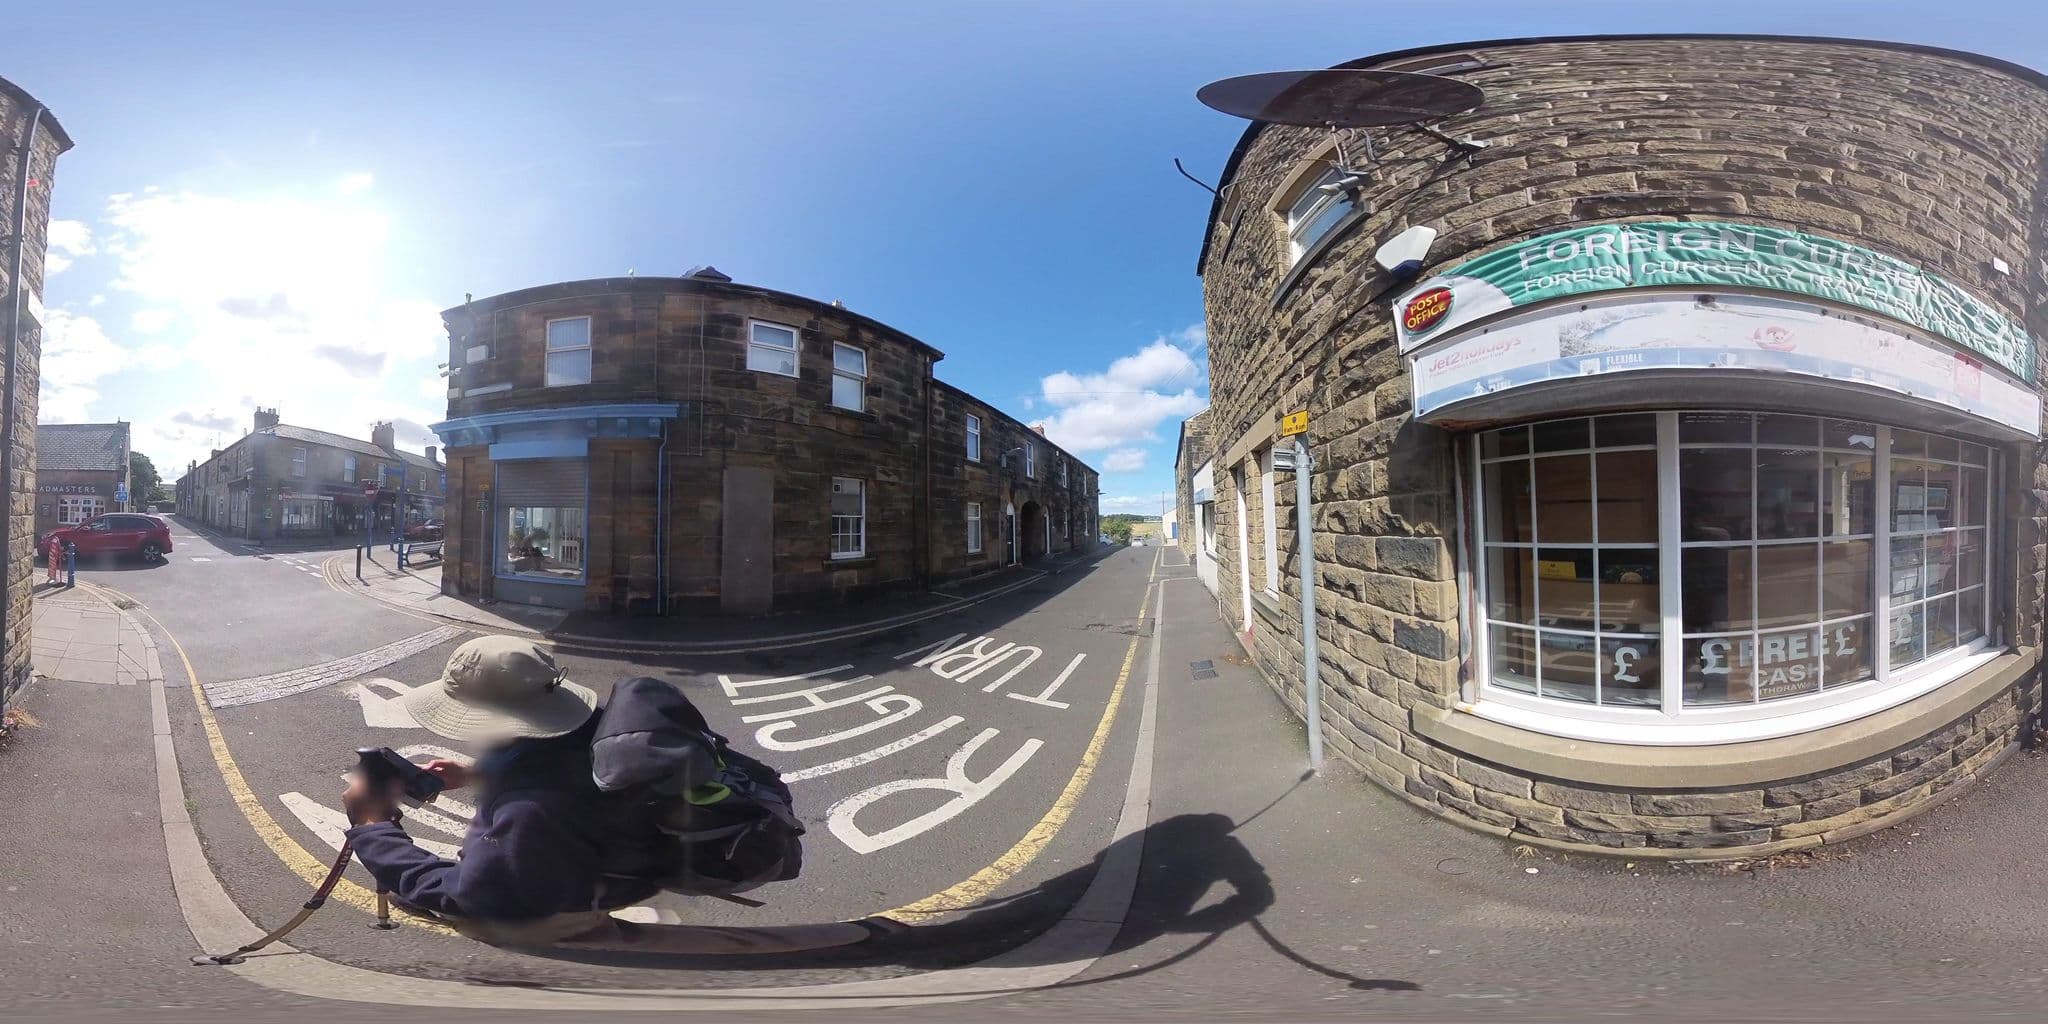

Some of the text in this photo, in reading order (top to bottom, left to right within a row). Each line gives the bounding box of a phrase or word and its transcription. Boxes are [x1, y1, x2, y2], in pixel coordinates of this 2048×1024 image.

[1519, 229, 1756, 271] FOREIGN
[1524, 264, 1633, 293] FOREIGN
[1641, 257, 1793, 284] CURRENCY
[1407, 302, 1446, 329] OFFICE
[1410, 292, 1441, 316] POST
[1429, 340, 1521, 373] Jet2holidays
[1606, 353, 1643, 366] FLEXIBLE
[1739, 631, 1831, 668] FREE
[893, 633, 1088, 709] TURN
[1748, 663, 1824, 688] CASH
[717, 664, 1045, 855] RIGHT
